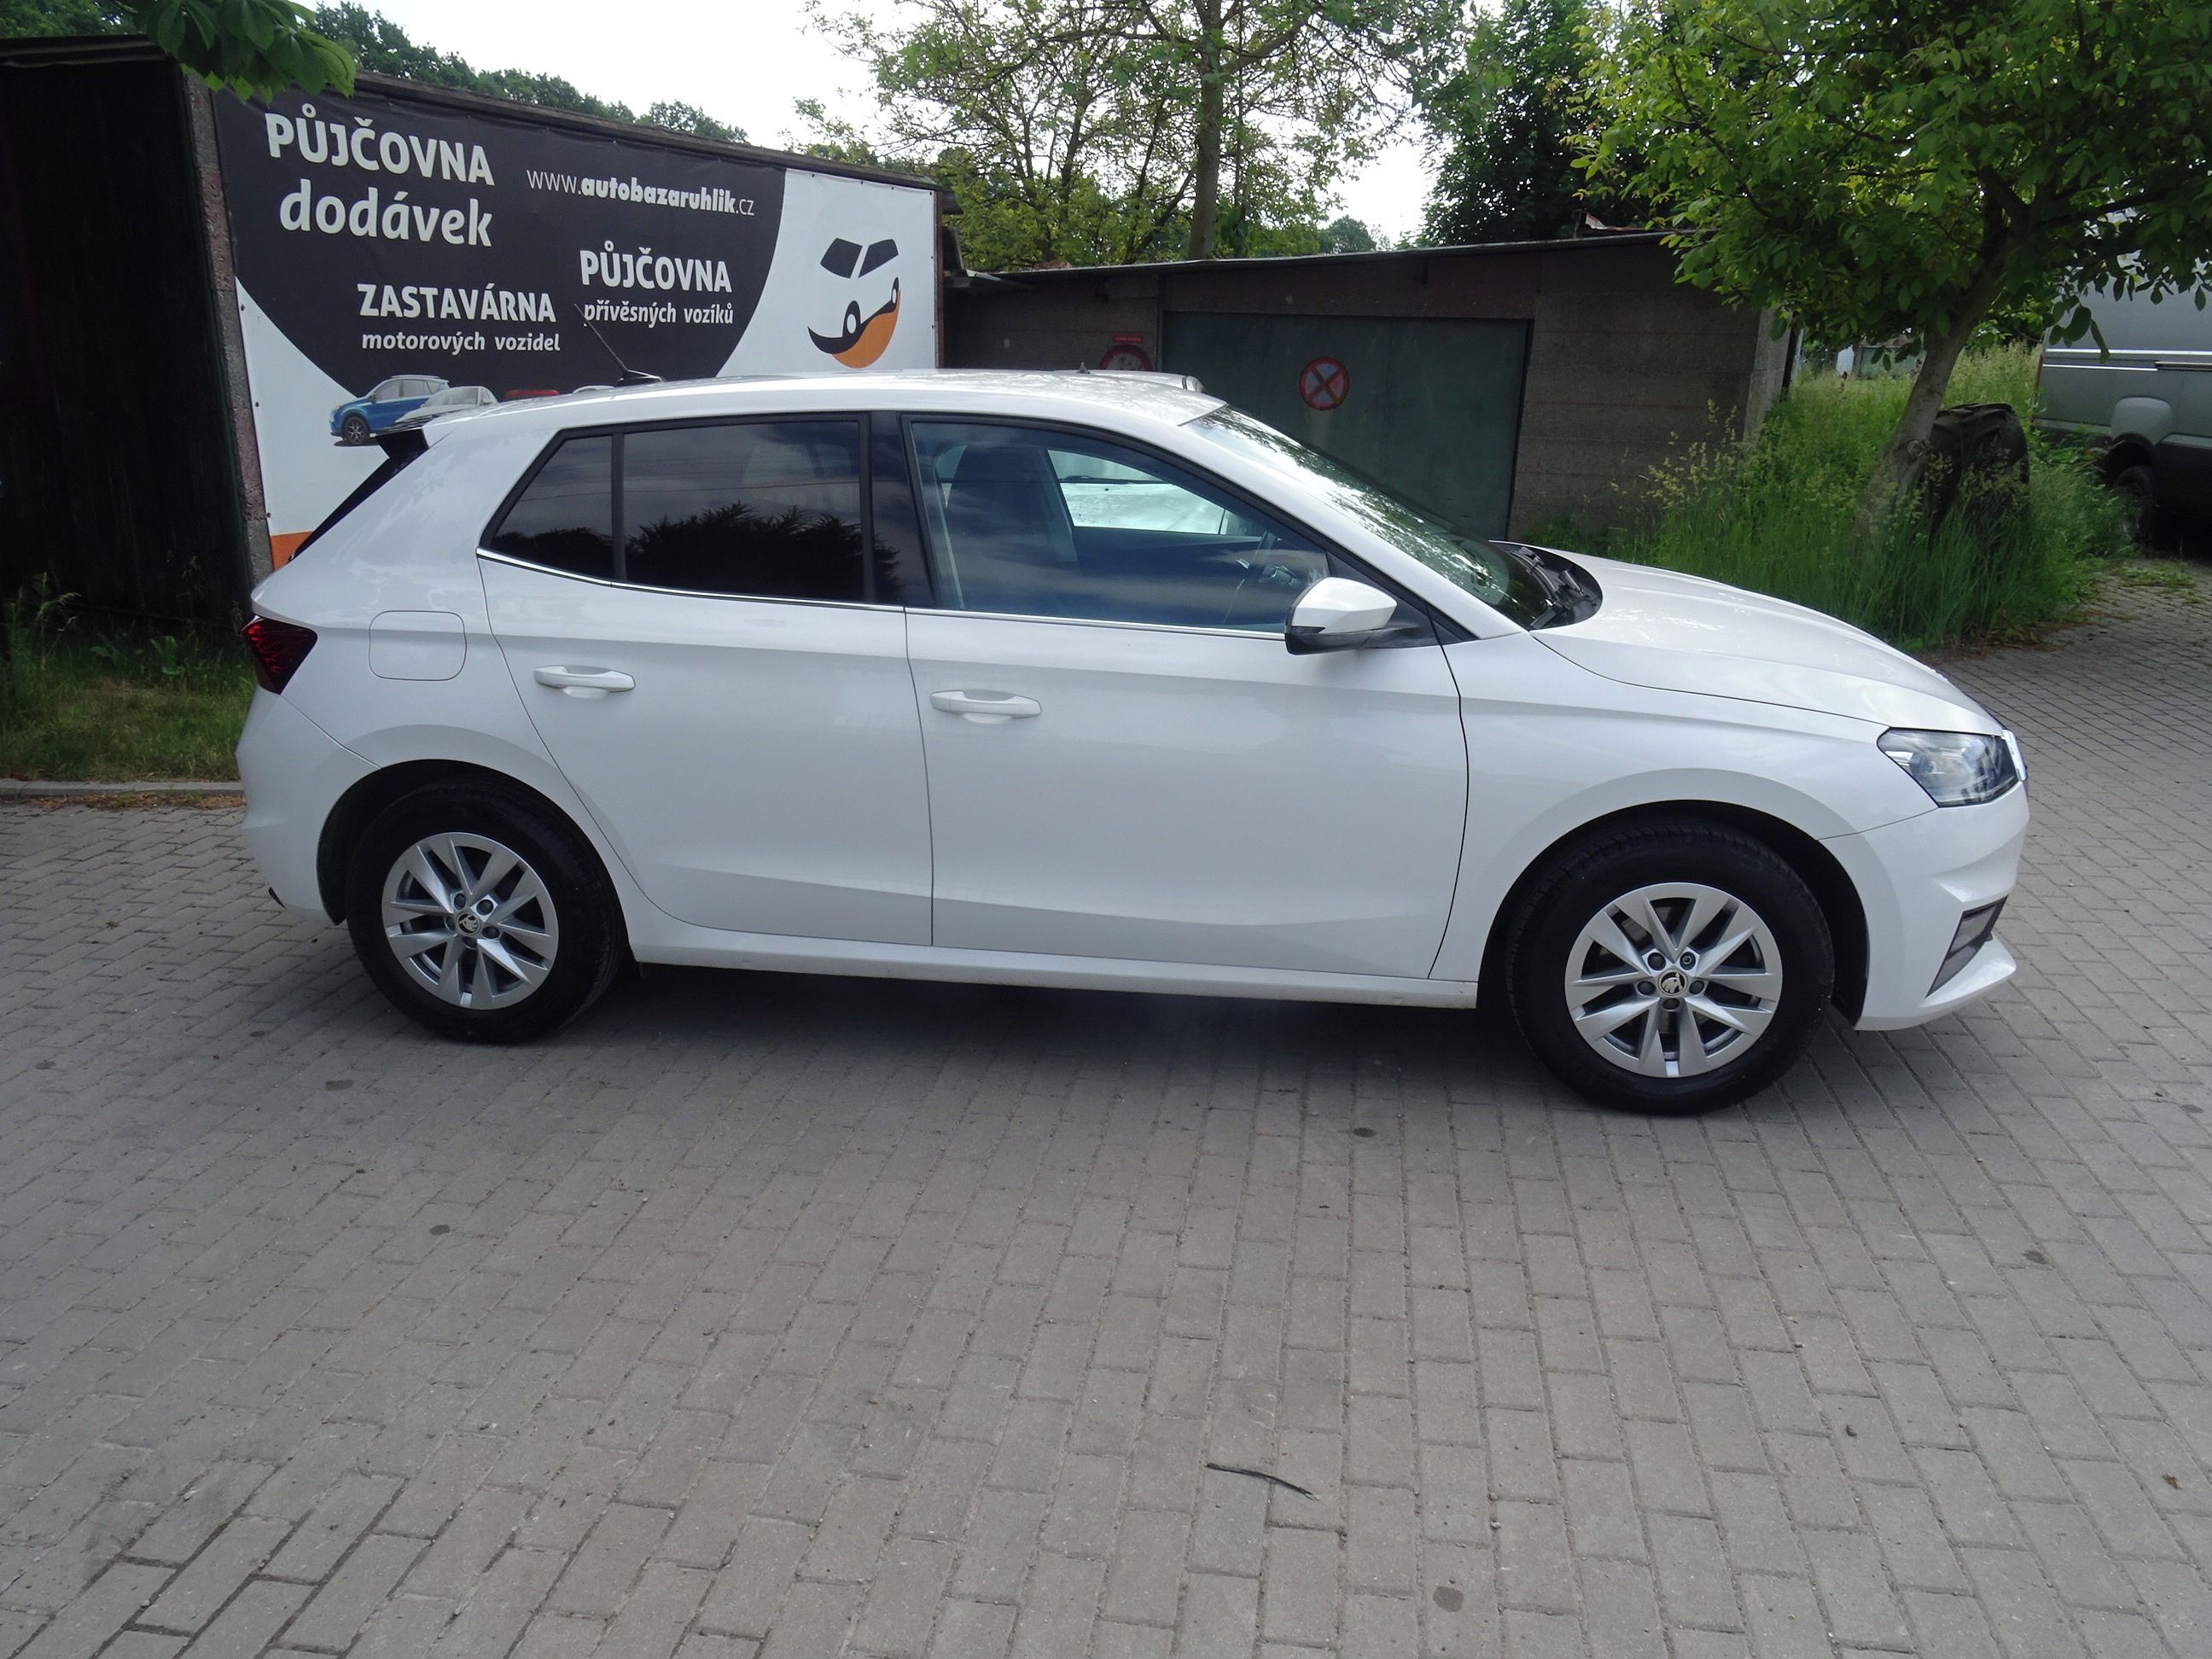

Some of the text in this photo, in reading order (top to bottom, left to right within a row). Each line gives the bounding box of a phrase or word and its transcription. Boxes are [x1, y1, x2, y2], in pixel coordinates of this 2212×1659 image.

[265, 103, 495, 186] PŮJČOVNA
[280, 178, 493, 247] dodávek
[527, 170, 754, 216] www.autobazaruhlik.cz
[580, 241, 732, 293] PŮJČOVNA
[357, 283, 556, 323] ZASTAVÁRNA
[584, 300, 734, 328] přívěsných vozíků
[362, 331, 560, 355] motorových vozidel
